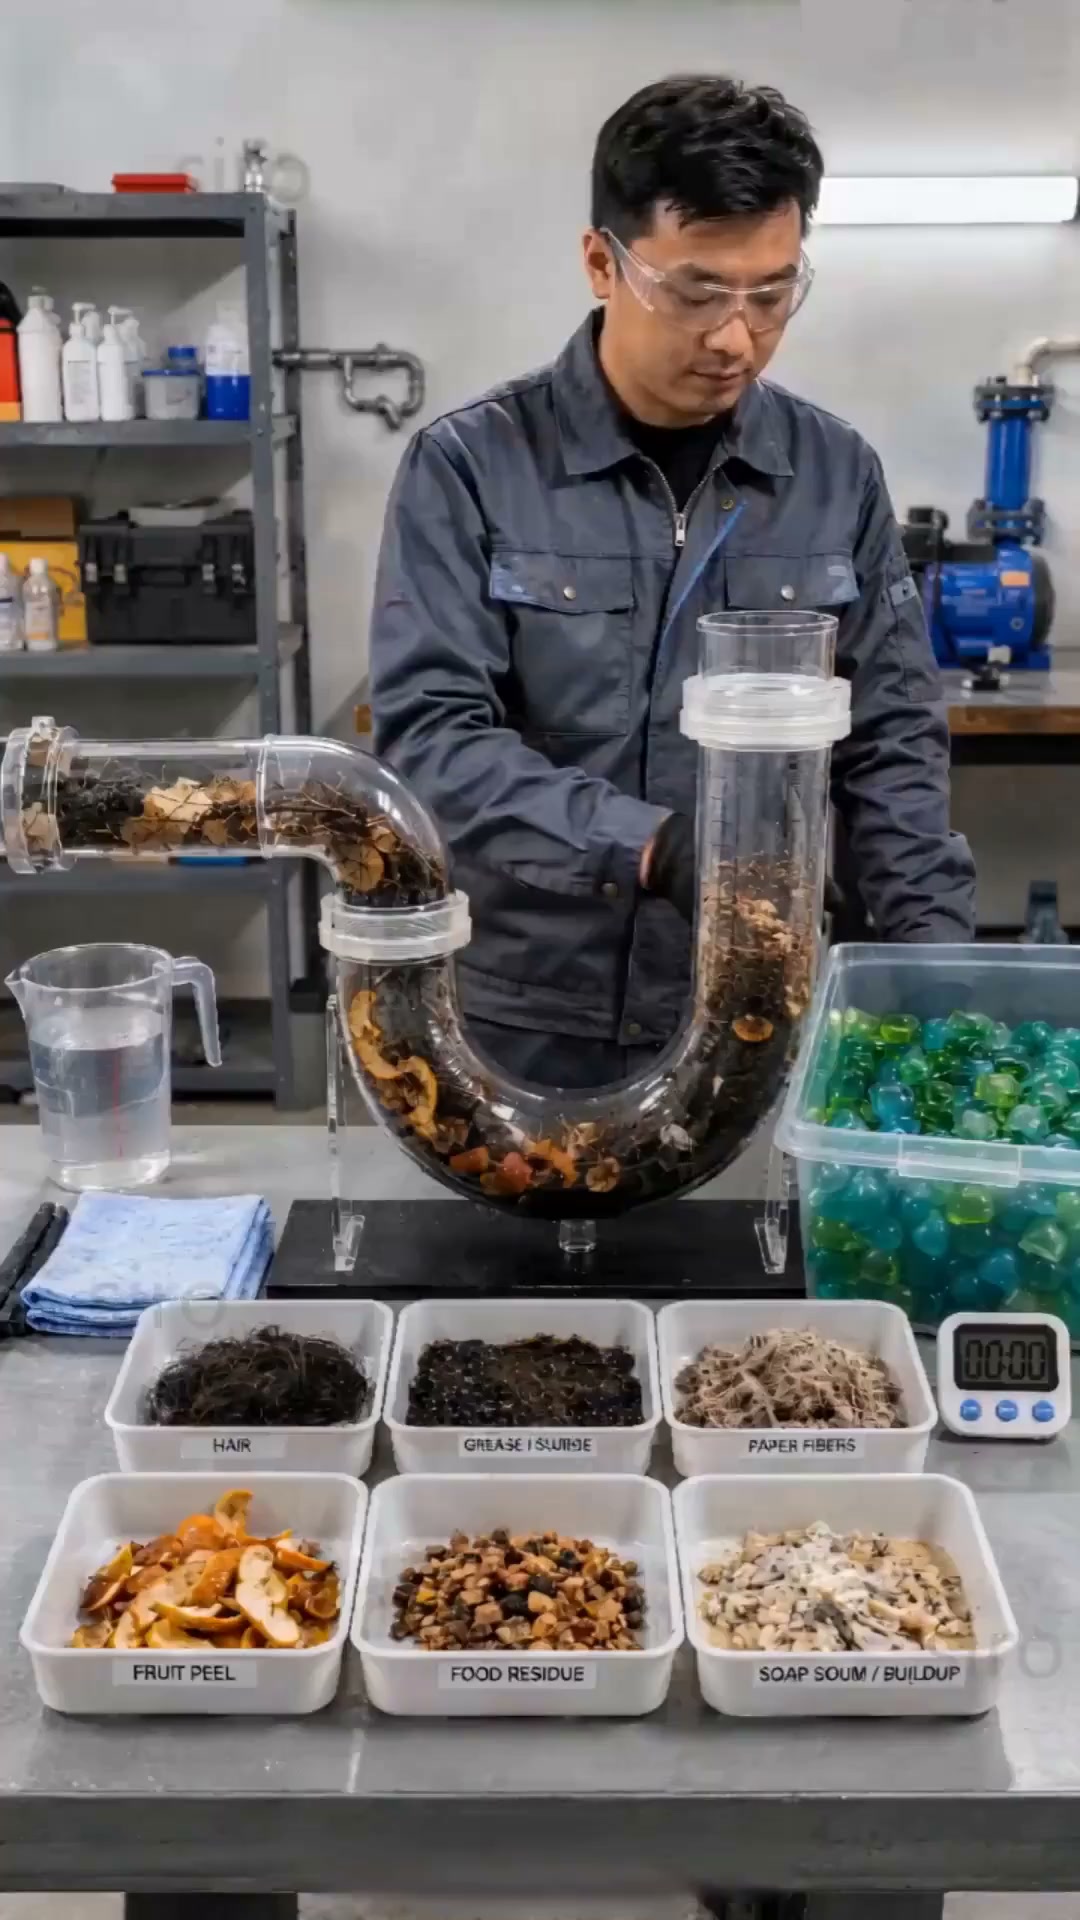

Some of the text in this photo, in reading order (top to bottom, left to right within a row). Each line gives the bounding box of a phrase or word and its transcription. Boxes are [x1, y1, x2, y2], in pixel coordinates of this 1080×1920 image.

[966, 1340, 1045, 1380] 00:00
[213, 1438, 251, 1452] HAIR
[464, 1438, 523, 1451] GREASE
[749, 1438, 856, 1453] PAPER FIBERS
[133, 1664, 236, 1681] FRUIT PEEL
[451, 1666, 584, 1681] FOOD RESIDUE
[759, 1666, 809, 1682] SOAP
[871, 1666, 880, 1682] /
[884, 1666, 960, 1683] BUILDUP
